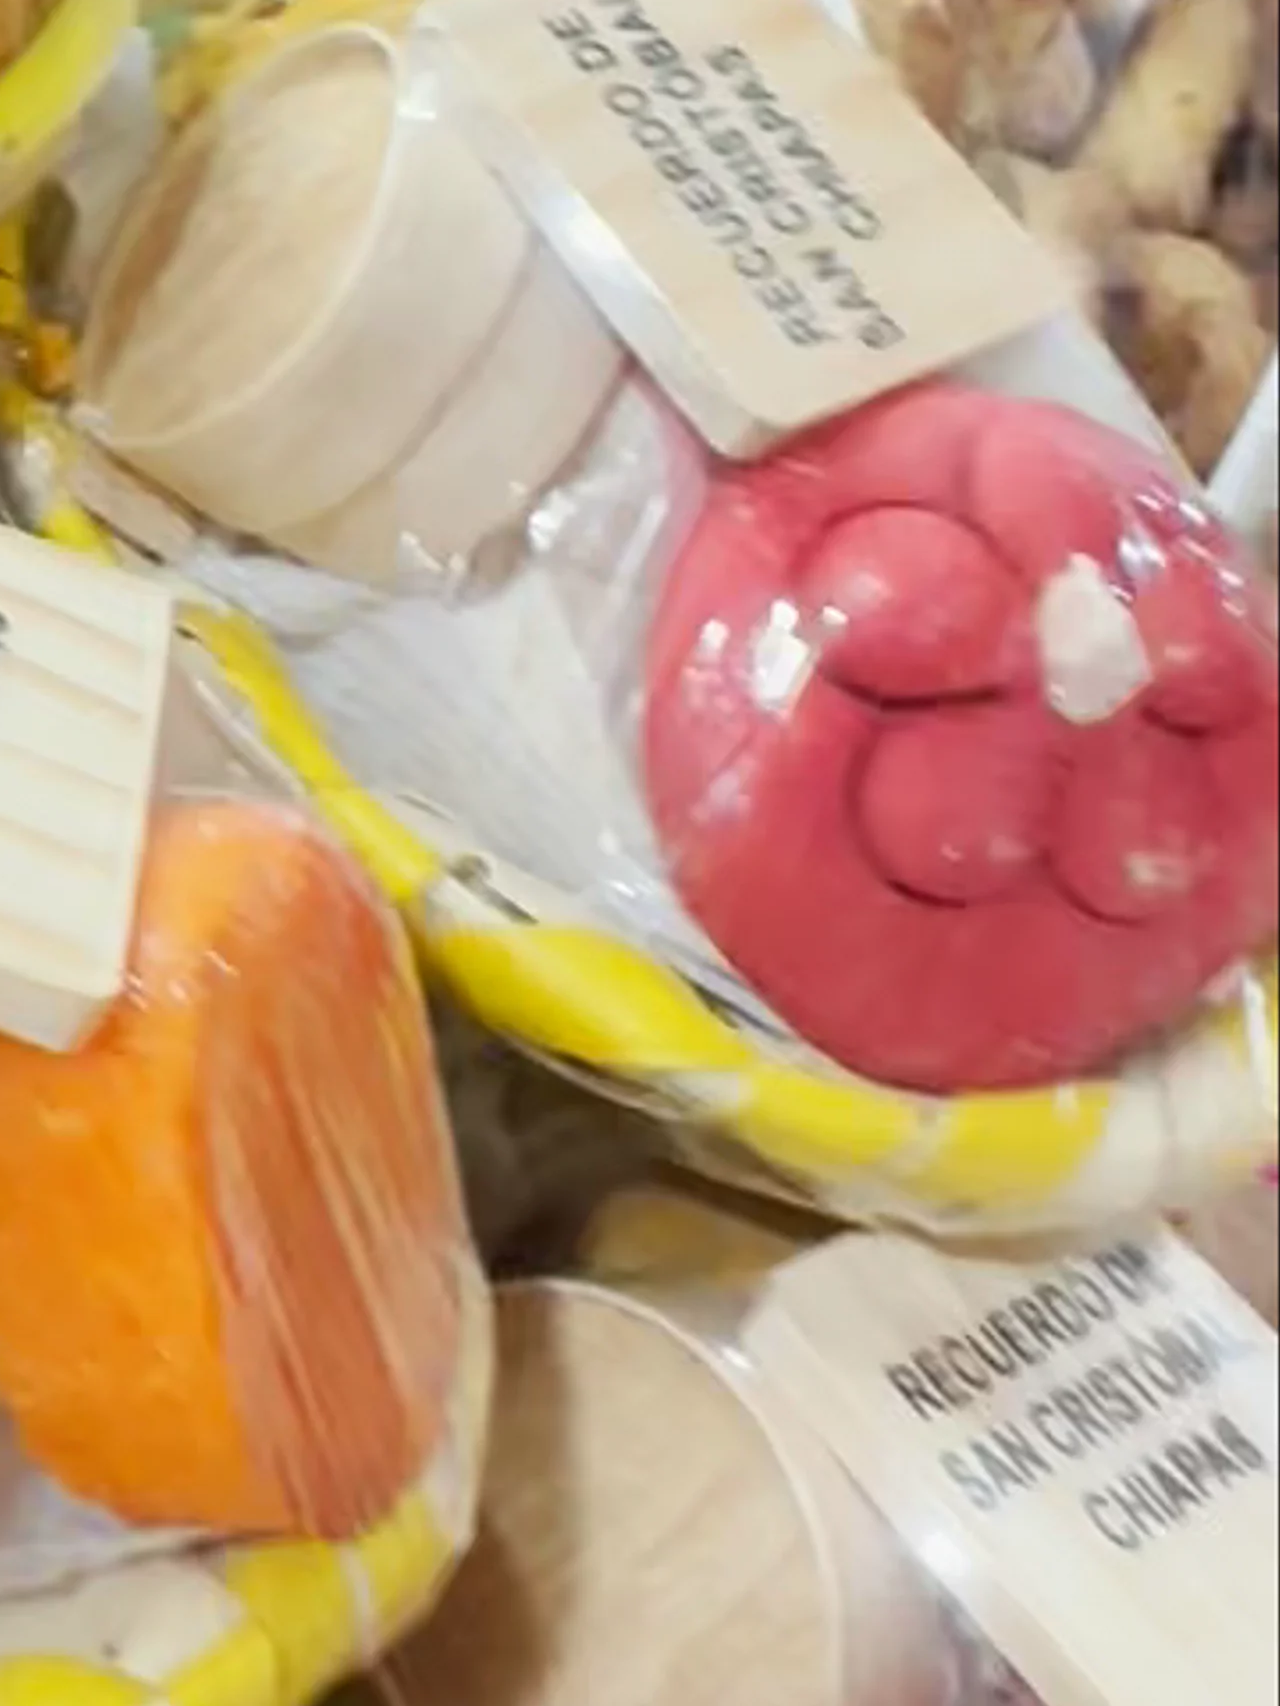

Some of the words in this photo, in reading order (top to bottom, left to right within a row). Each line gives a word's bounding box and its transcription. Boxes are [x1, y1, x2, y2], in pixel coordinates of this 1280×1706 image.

[542, 7, 619, 74] DE
[705, 44, 883, 241] CHIAPAS
[604, 85, 836, 348] RECUERDO
[800, 246, 907, 351] SAN
[884, 1266, 1116, 1422] RECUERDO
[941, 1437, 1051, 1512] SAN
